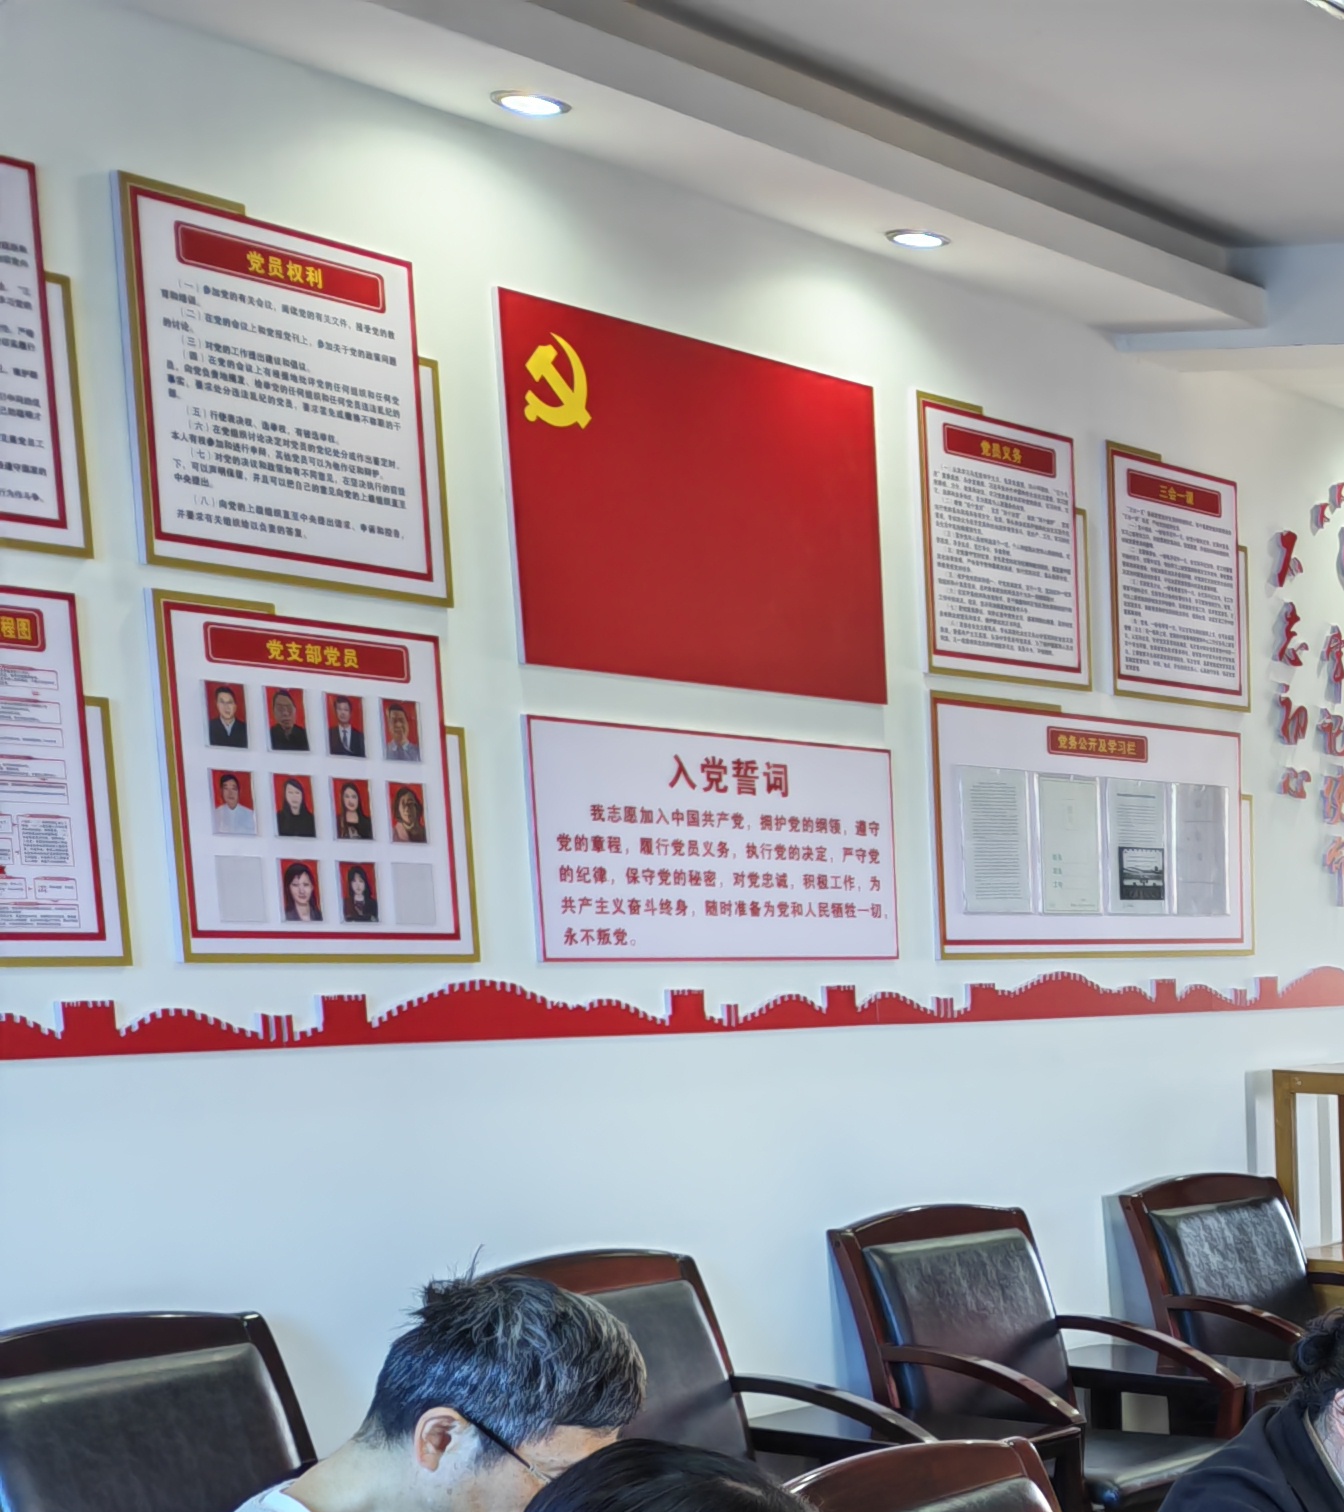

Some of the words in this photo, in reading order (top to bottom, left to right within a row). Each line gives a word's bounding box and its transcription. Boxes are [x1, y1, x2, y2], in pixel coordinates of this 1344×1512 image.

[246, 251, 324, 290] 党员权利
[980, 440, 1023, 464] 党员义务
[1159, 484, 1194, 505] 三会一课
[266, 639, 359, 669] 党支部党员
[668, 754, 789, 798] 入党誓词
[590, 804, 880, 838] 我志愿加入中国共产党，拥护党的纲领，遵守
[557, 834, 880, 865] 党的章程，履行党员义务，执行党的决定，严守党
[559, 865, 881, 893] 的纪律，保守党的秘密，对党忠诚，积极工作，为
[564, 928, 636, 947] 永不叛党。
